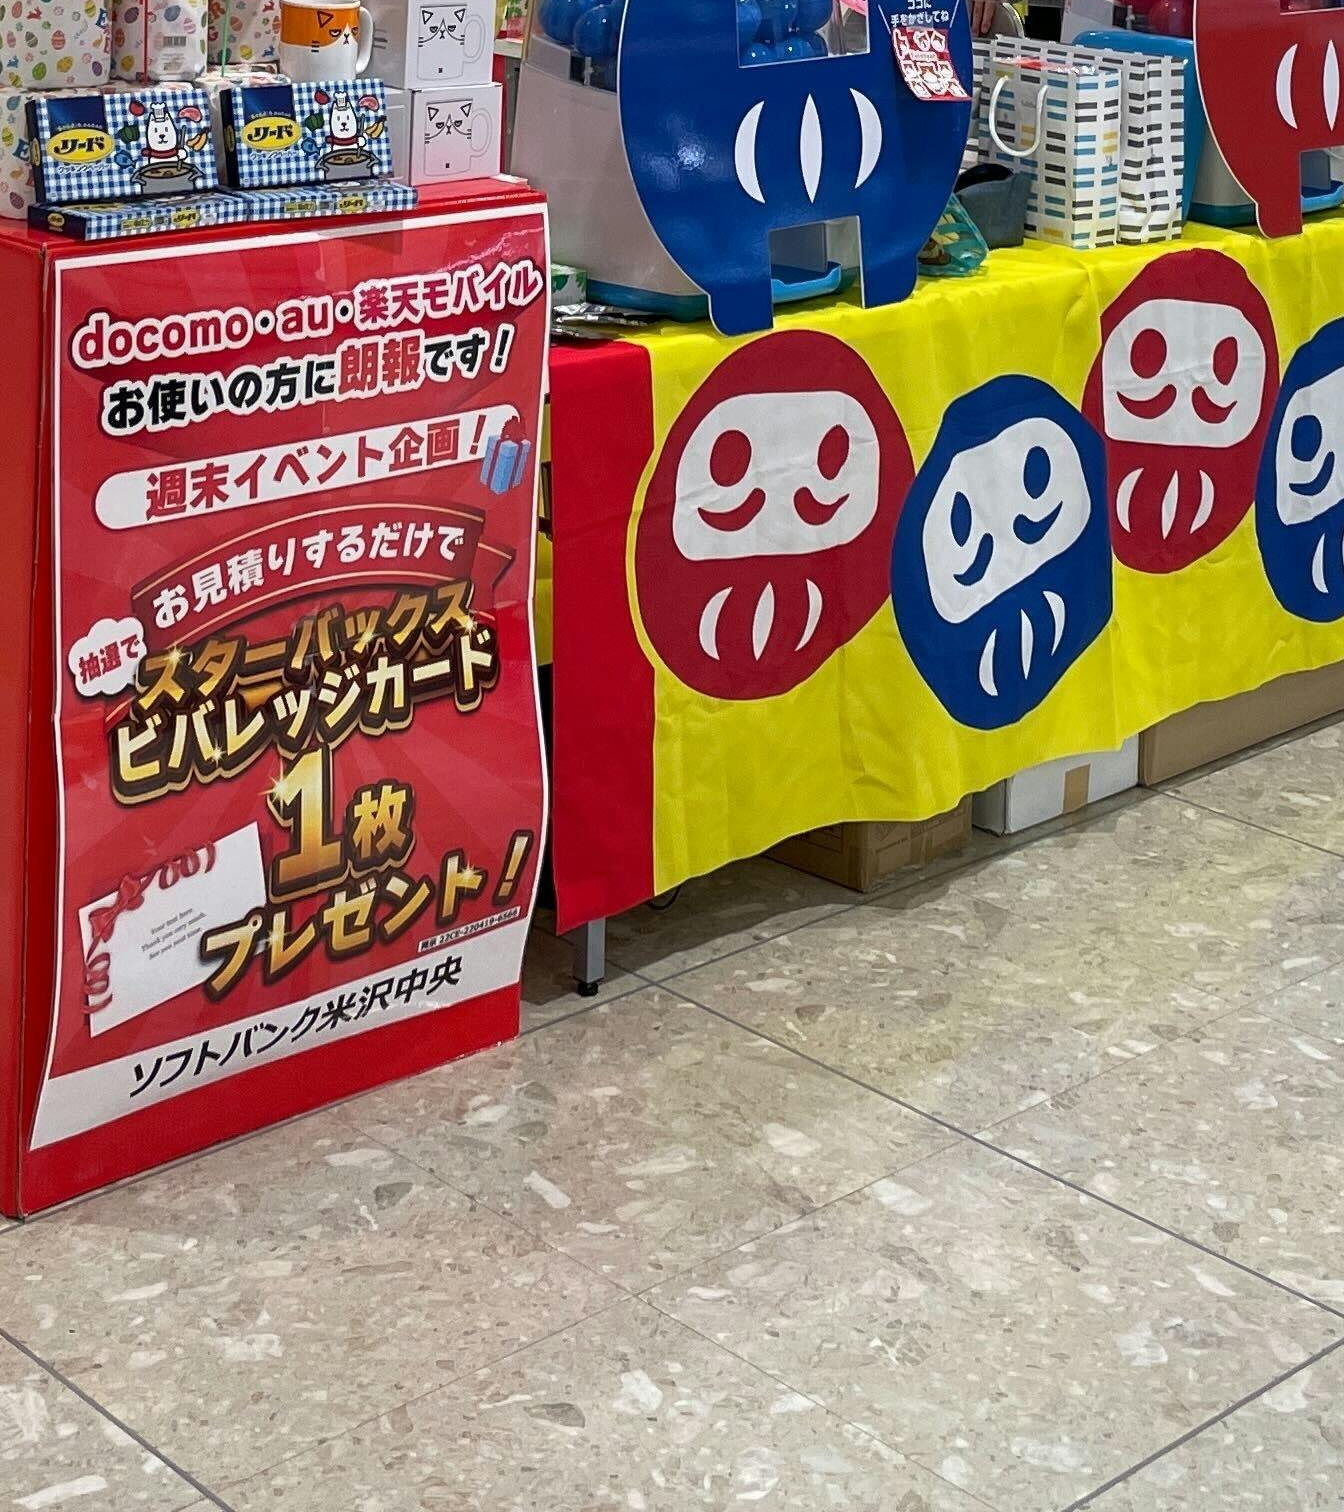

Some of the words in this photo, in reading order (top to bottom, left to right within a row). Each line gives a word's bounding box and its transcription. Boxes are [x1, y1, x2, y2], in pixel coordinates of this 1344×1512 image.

[53, 134, 106, 155] リード
[247, 123, 294, 143] リード
[105, 330, 511, 428] お使いの方に朗報です!
[144, 415, 486, 522] 週末イベント企画!
[153, 520, 467, 629] お見積りするだけで
[78, 636, 142, 686] 抽選で
[137, 579, 476, 709] スターバックス
[115, 625, 497, 783] ビバレッジカード
[271, 748, 409, 885] 1枚
[205, 834, 530, 993] プレゼント!
[129, 954, 462, 1097] ソフトバンク米沢中央
